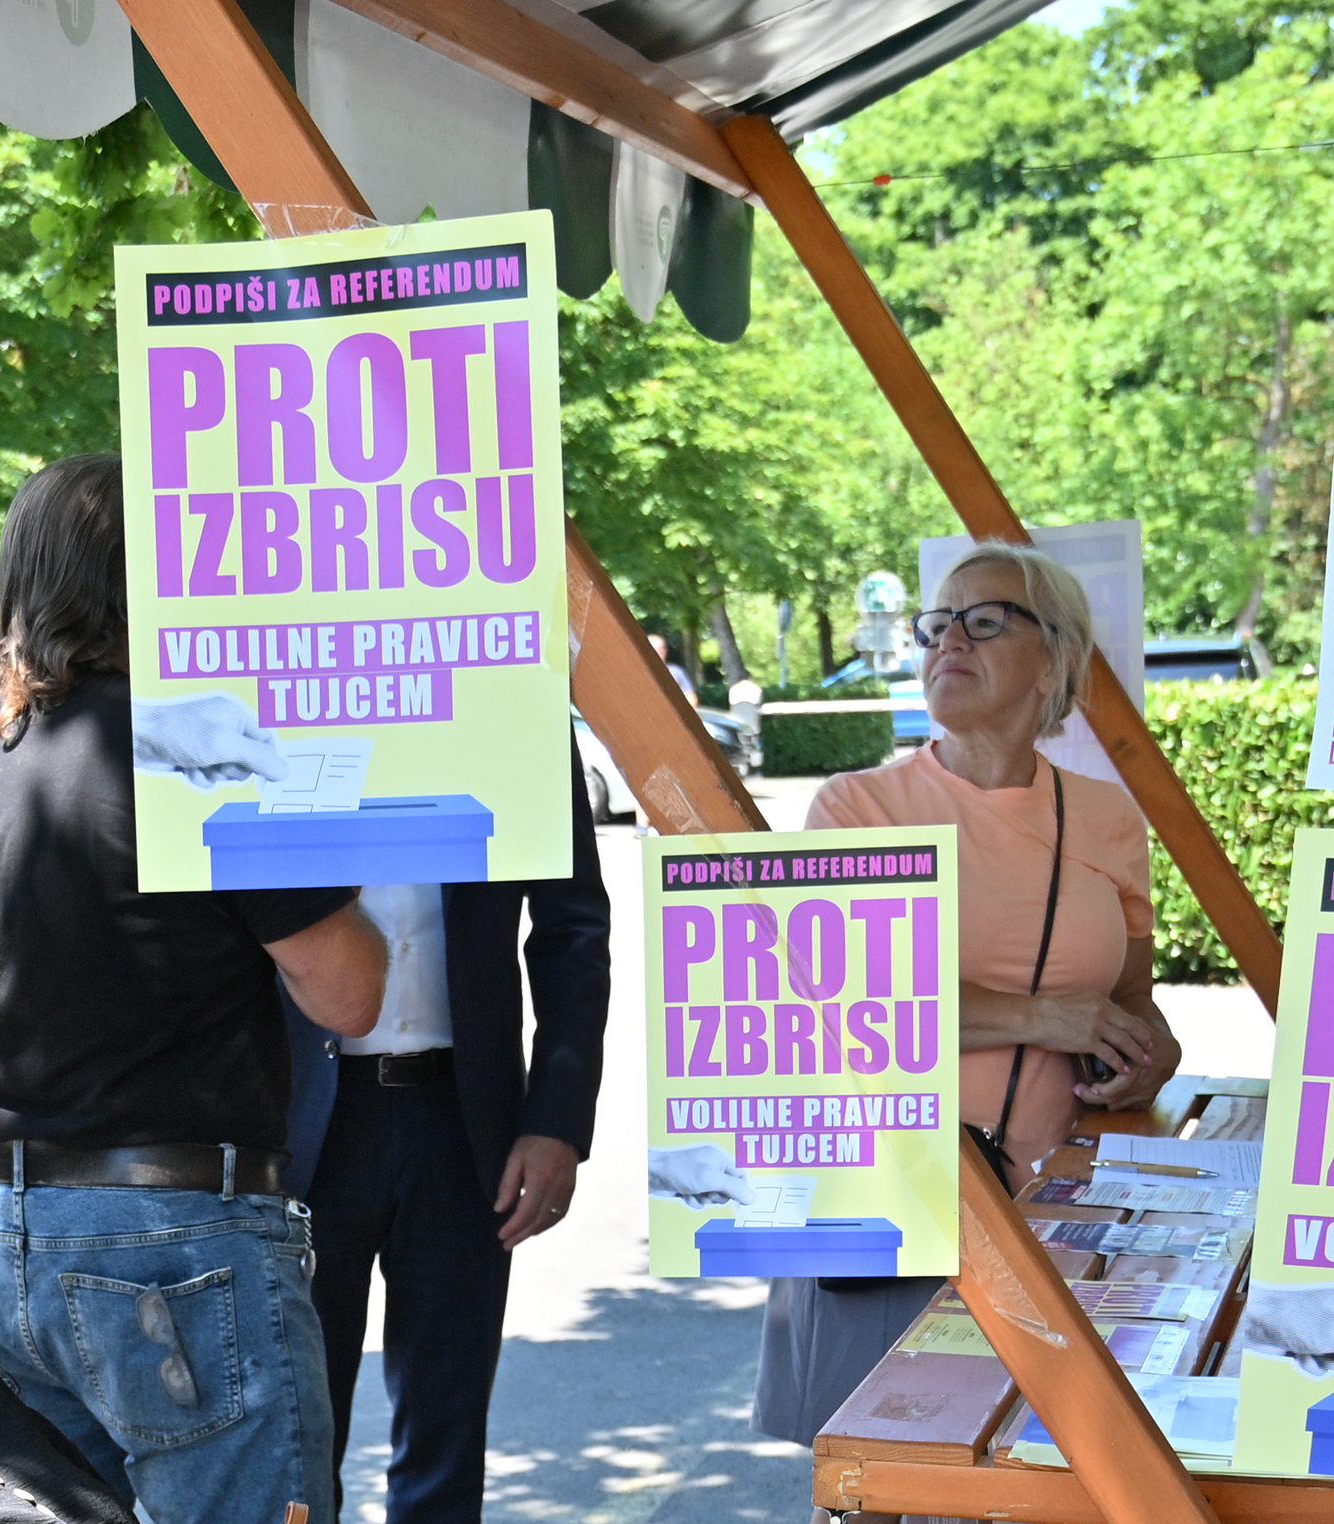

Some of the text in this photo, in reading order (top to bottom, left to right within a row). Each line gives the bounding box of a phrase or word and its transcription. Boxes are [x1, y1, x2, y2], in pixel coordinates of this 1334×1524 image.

[154, 255, 519, 315] PODPIŠI ZA REFERENDUM
[148, 320, 534, 489] PROTI
[154, 473, 536, 598] IZBRISU
[165, 615, 534, 673] VOLILNE PRAVICE
[269, 675, 433, 720] TUJCEM
[668, 853, 932, 884] PODPIŠI ZA REFERENDUM
[662, 896, 938, 1003] PROTI
[665, 1000, 939, 1077] IZBRISU
[671, 1096, 934, 1129] VOLILNE PRAVICE
[743, 1134, 860, 1163] TUJCEM
